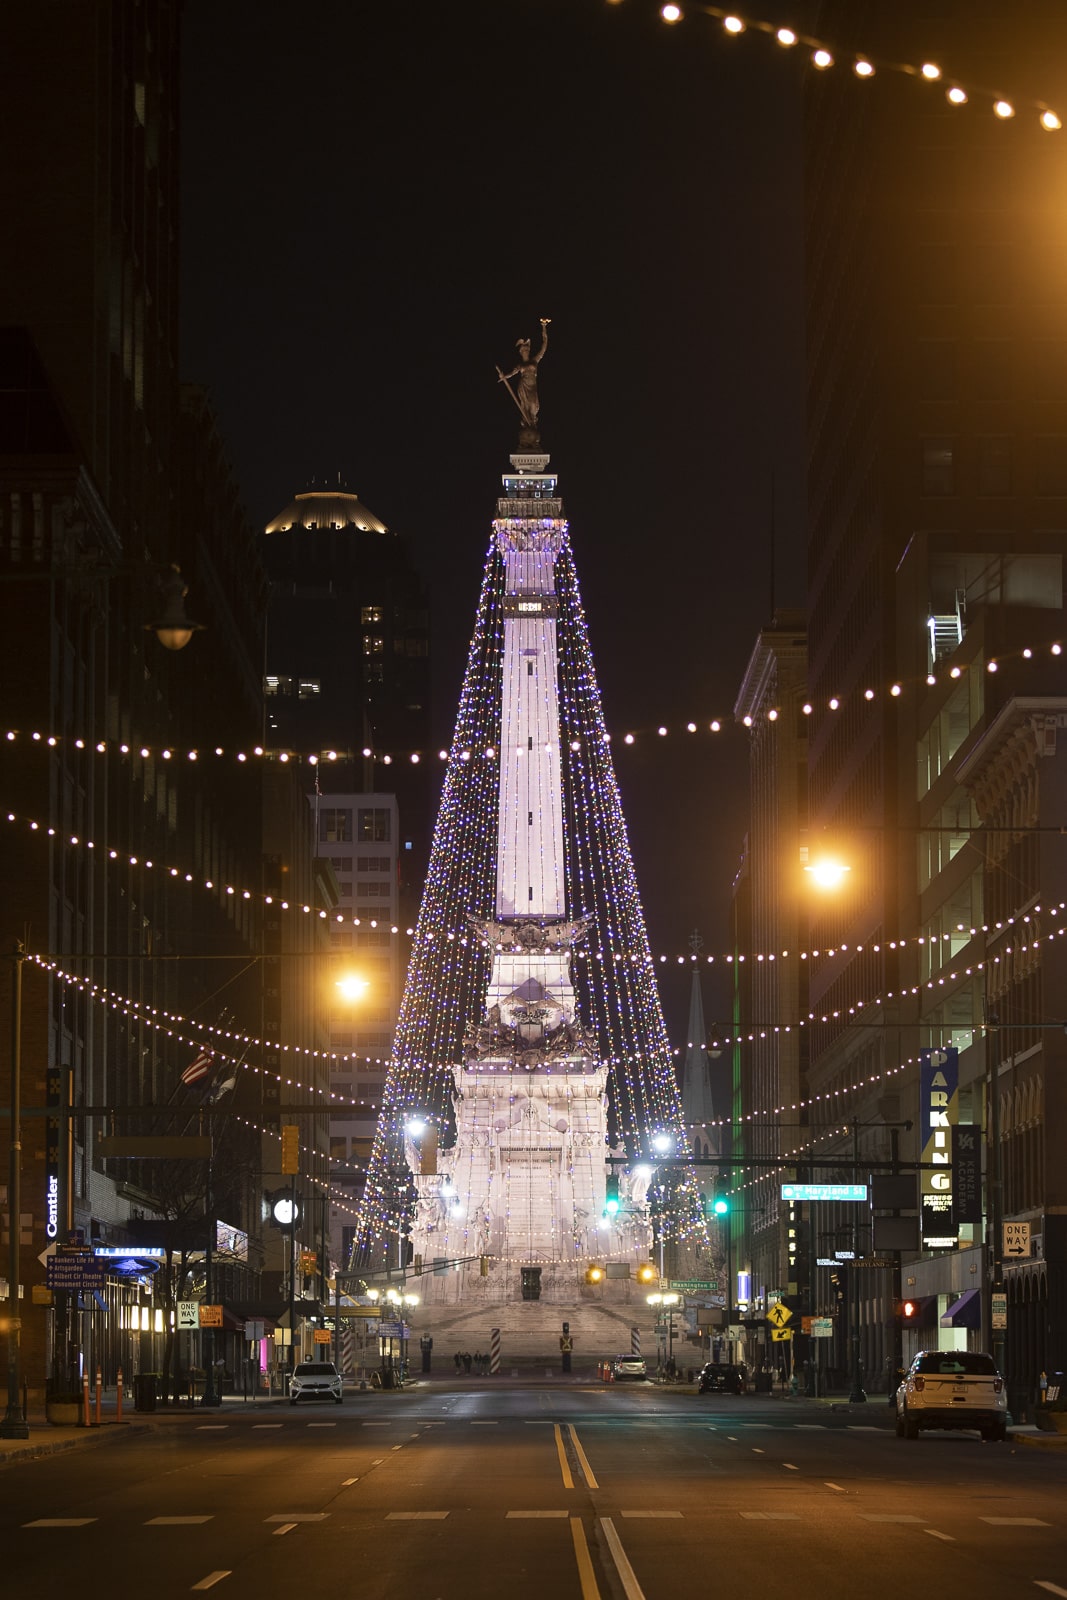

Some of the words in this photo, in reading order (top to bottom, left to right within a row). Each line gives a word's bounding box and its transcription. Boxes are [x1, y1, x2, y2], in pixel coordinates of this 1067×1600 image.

[929, 1051, 950, 1190] PARKING
[805, 1186, 849, 1197] Maryland
[853, 1186, 863, 1195] St
[958, 1160, 967, 1214] ACADEMY
[967, 1160, 975, 1200] KENZIE
[47, 1175, 58, 1238] Centier
[1006, 1236, 1028, 1245] WAY
[1007, 1226, 1027, 1234] ONE
